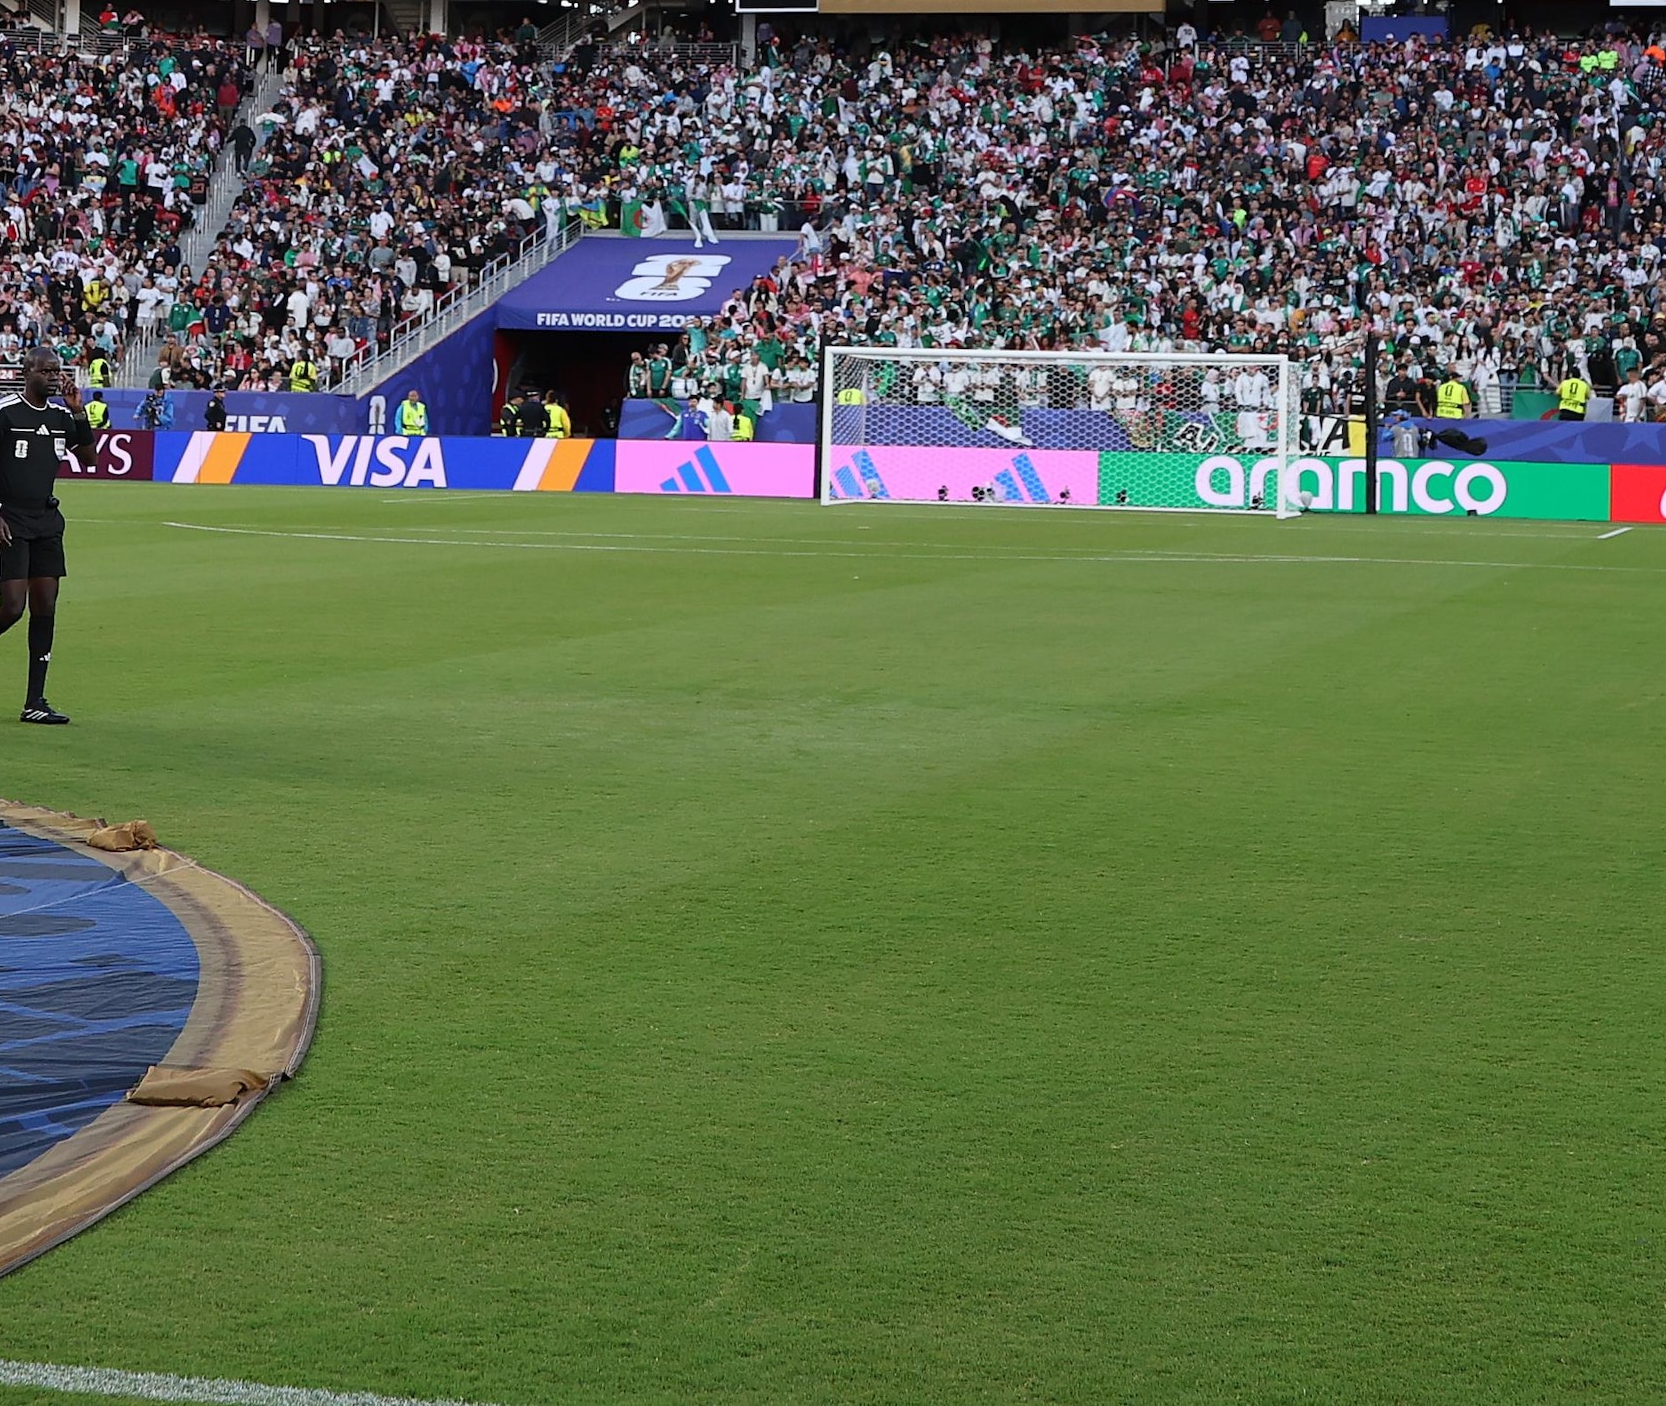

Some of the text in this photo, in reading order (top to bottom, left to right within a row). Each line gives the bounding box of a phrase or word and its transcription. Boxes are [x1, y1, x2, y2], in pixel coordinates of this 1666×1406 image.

[638, 290, 679, 298] FIFA
[537, 313, 570, 326] FIFA
[571, 314, 626, 327] WORLD
[627, 315, 657, 327] CUP
[224, 415, 287, 433] FIFA
[302, 434, 447, 487] VISA
[1195, 455, 1508, 515] aramco
